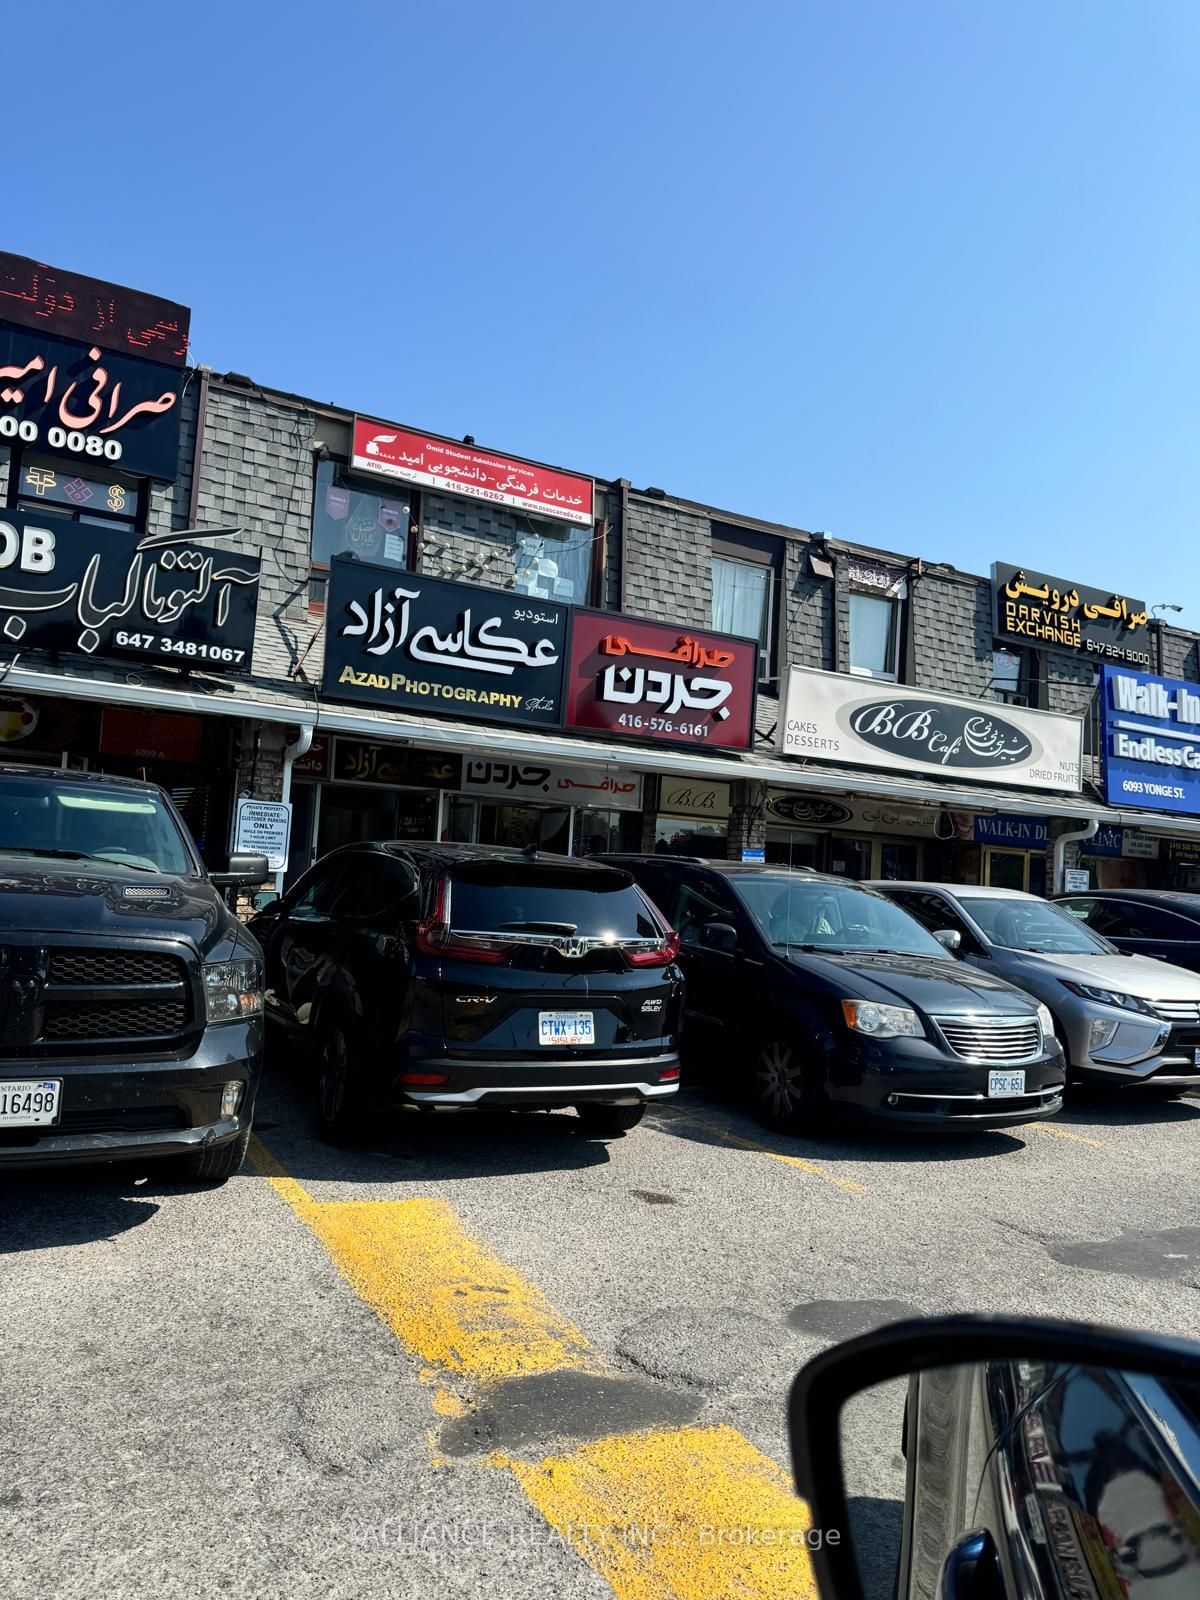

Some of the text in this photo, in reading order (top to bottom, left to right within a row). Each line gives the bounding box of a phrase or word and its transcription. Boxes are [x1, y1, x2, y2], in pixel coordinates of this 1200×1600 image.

[60, 346, 177, 434] صرافی
[48, 426, 122, 461] 0080
[398, 451, 424, 466] امید
[426, 444, 535, 477] Omid Student Admission Services
[445, 481, 505, 502] 416-221-6262
[542, 487, 583, 505] خدمات
[513, 606, 559, 625] استودیو
[1005, 570, 1148, 631] صرافی درویش
[342, 586, 560, 675] عکاسی آزاد
[1006, 601, 1081, 633] DARVISH
[1007, 617, 1081, 648] EXCHANGE
[115, 631, 246, 664] 647 3481067
[603, 633, 735, 669] صرافی
[603, 664, 733, 721] جردن
[786, 733, 840, 751] DESSERTS
[787, 720, 818, 734] CAKES
[1114, 733, 1182, 766] Endless
[466, 760, 636, 794] صرافی جردن
[1029, 769, 1080, 785] DRIED FRUITS
[1059, 761, 1080, 773] NUTS
[1122, 779, 1144, 793] 6093
[1143, 783, 1174, 798] YONGE
[253, 822, 274, 830] ONLY
[978, 818, 1031, 849] WALK-IN
[455, 995, 498, 1003] CR-V
[1, 1093, 54, 1114] 16498
